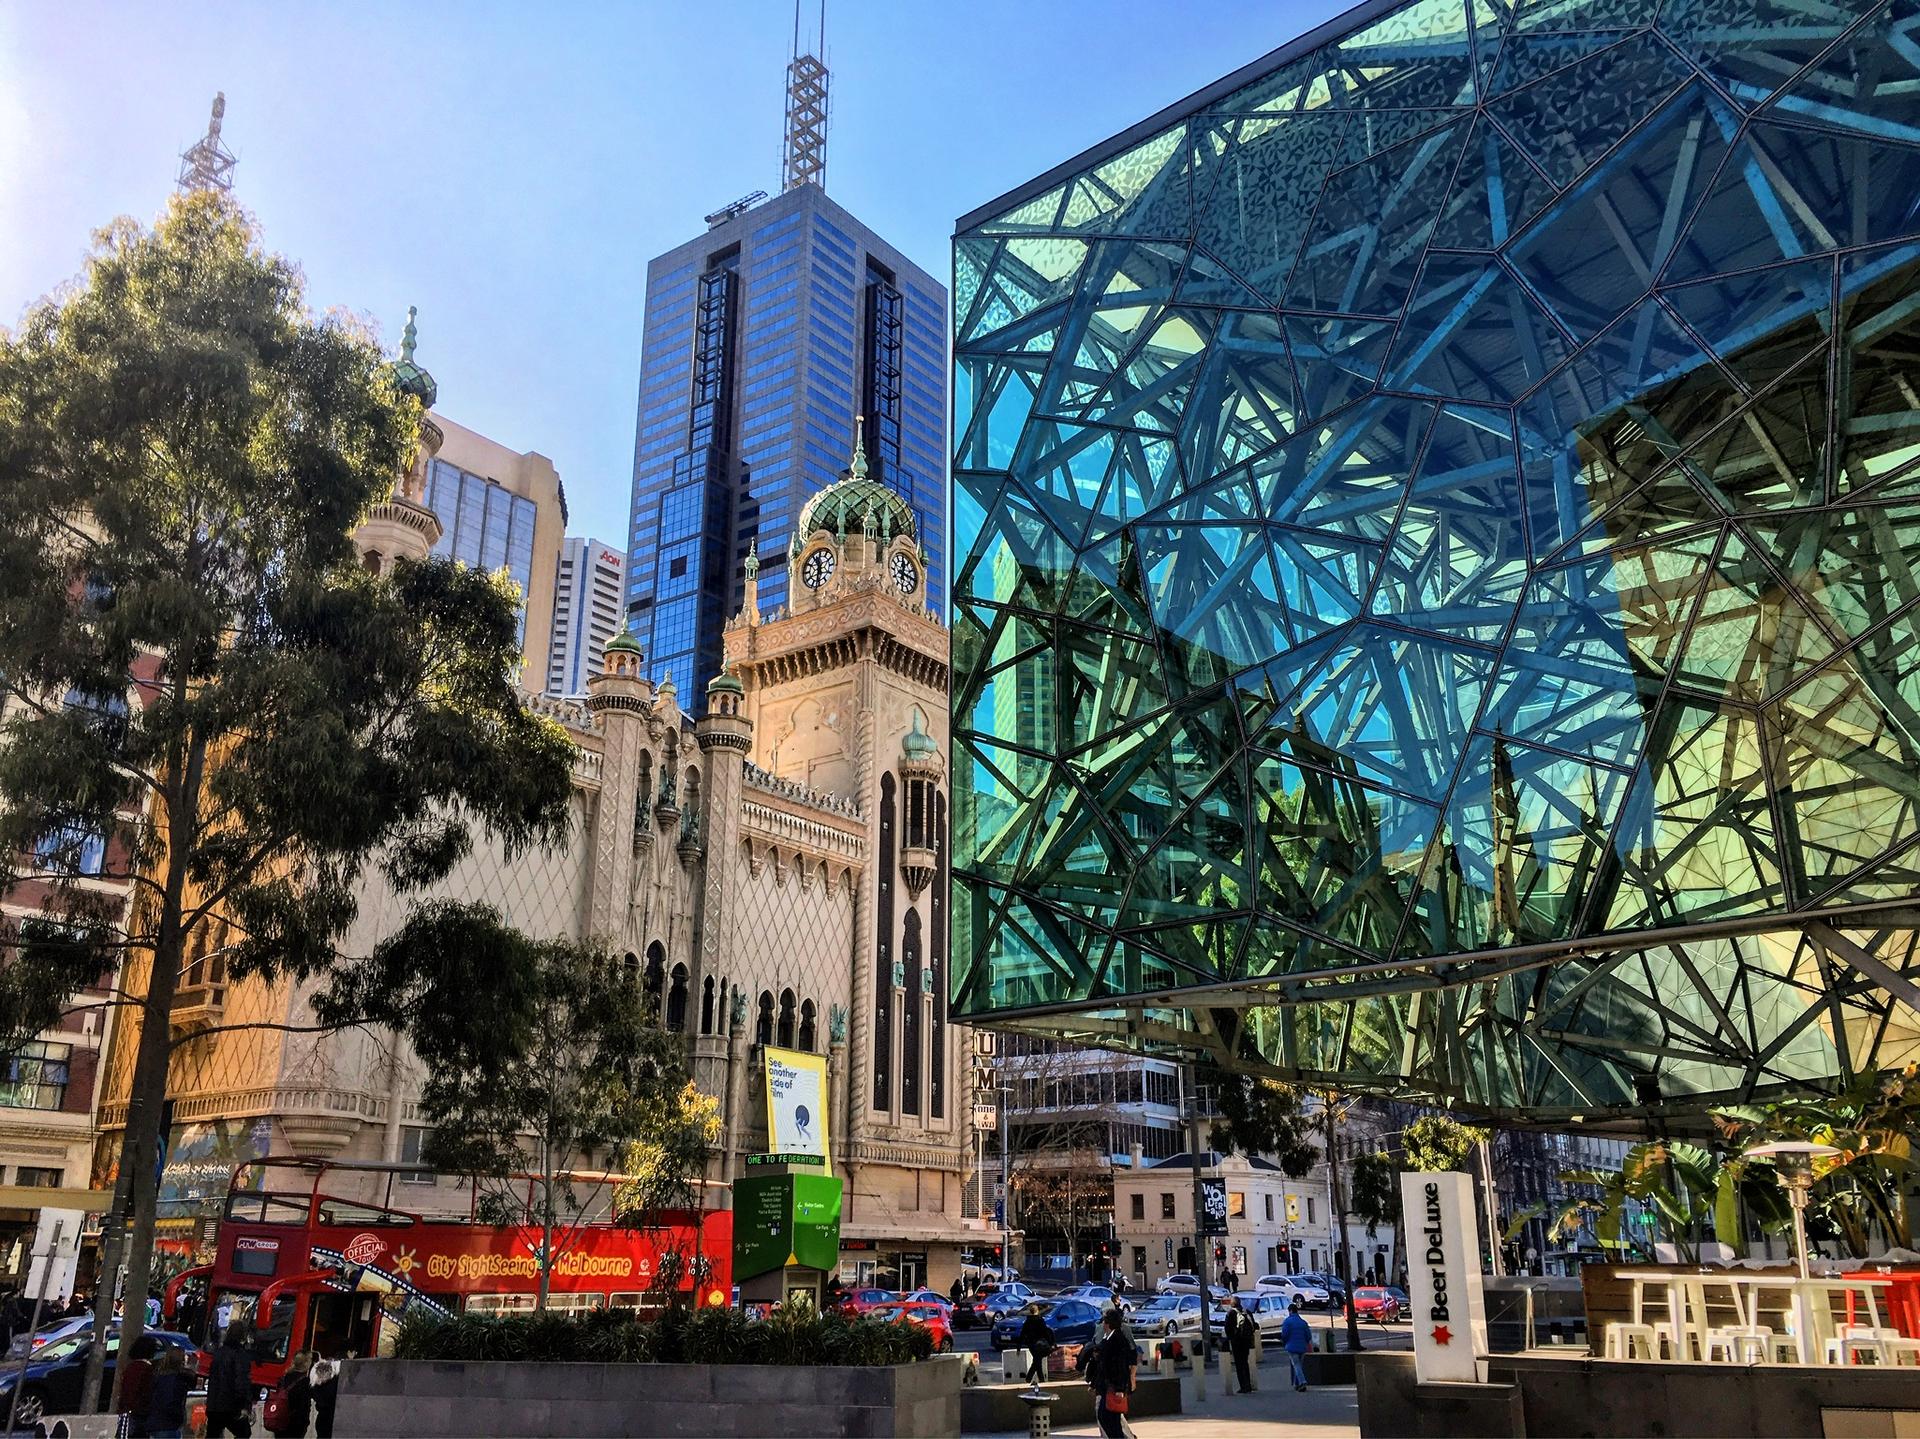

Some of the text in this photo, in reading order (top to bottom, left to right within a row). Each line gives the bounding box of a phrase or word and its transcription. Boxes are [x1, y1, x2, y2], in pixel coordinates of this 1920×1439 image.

[769, 1057, 782, 1068] See
[769, 1067, 797, 1079] another
[770, 1077, 793, 1089] side of
[778, 1155, 820, 1165] FEDERATION
[347, 1243, 385, 1259] OFFICIAL
[1424, 1182, 1450, 1322] Beer DeLuxe
[358, 1253, 376, 1264] TOUR
[427, 1254, 457, 1277] City
[457, 1254, 537, 1279] SightSeeing
[557, 1251, 632, 1277] Melbourne
